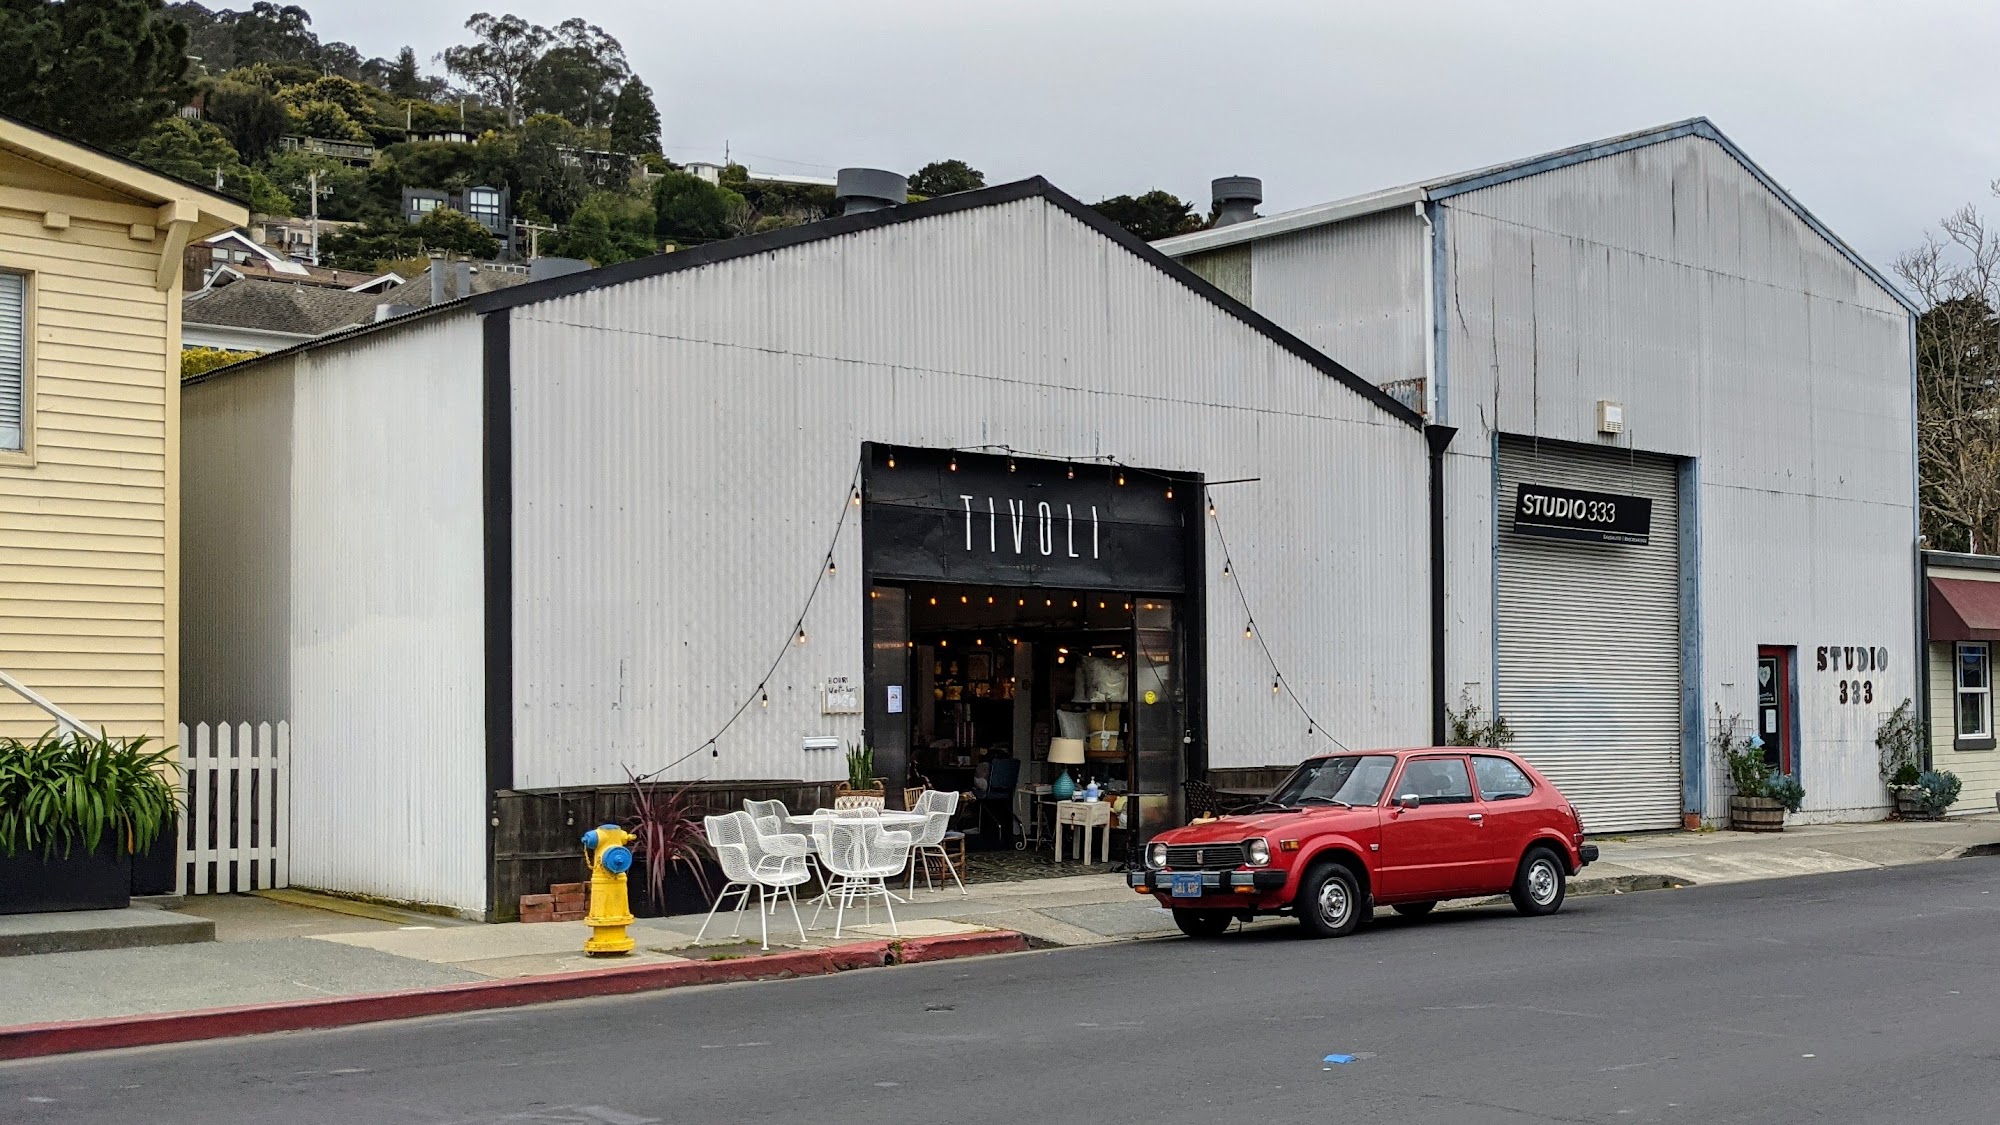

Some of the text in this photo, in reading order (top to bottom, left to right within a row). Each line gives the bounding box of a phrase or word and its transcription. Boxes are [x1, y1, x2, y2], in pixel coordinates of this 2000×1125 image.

[1522, 494, 1616, 523] STUDIO 333
[960, 494, 1099, 560] TIVOLI
[1817, 646, 1888, 672] STUDIO
[1839, 680, 1873, 705] 333
